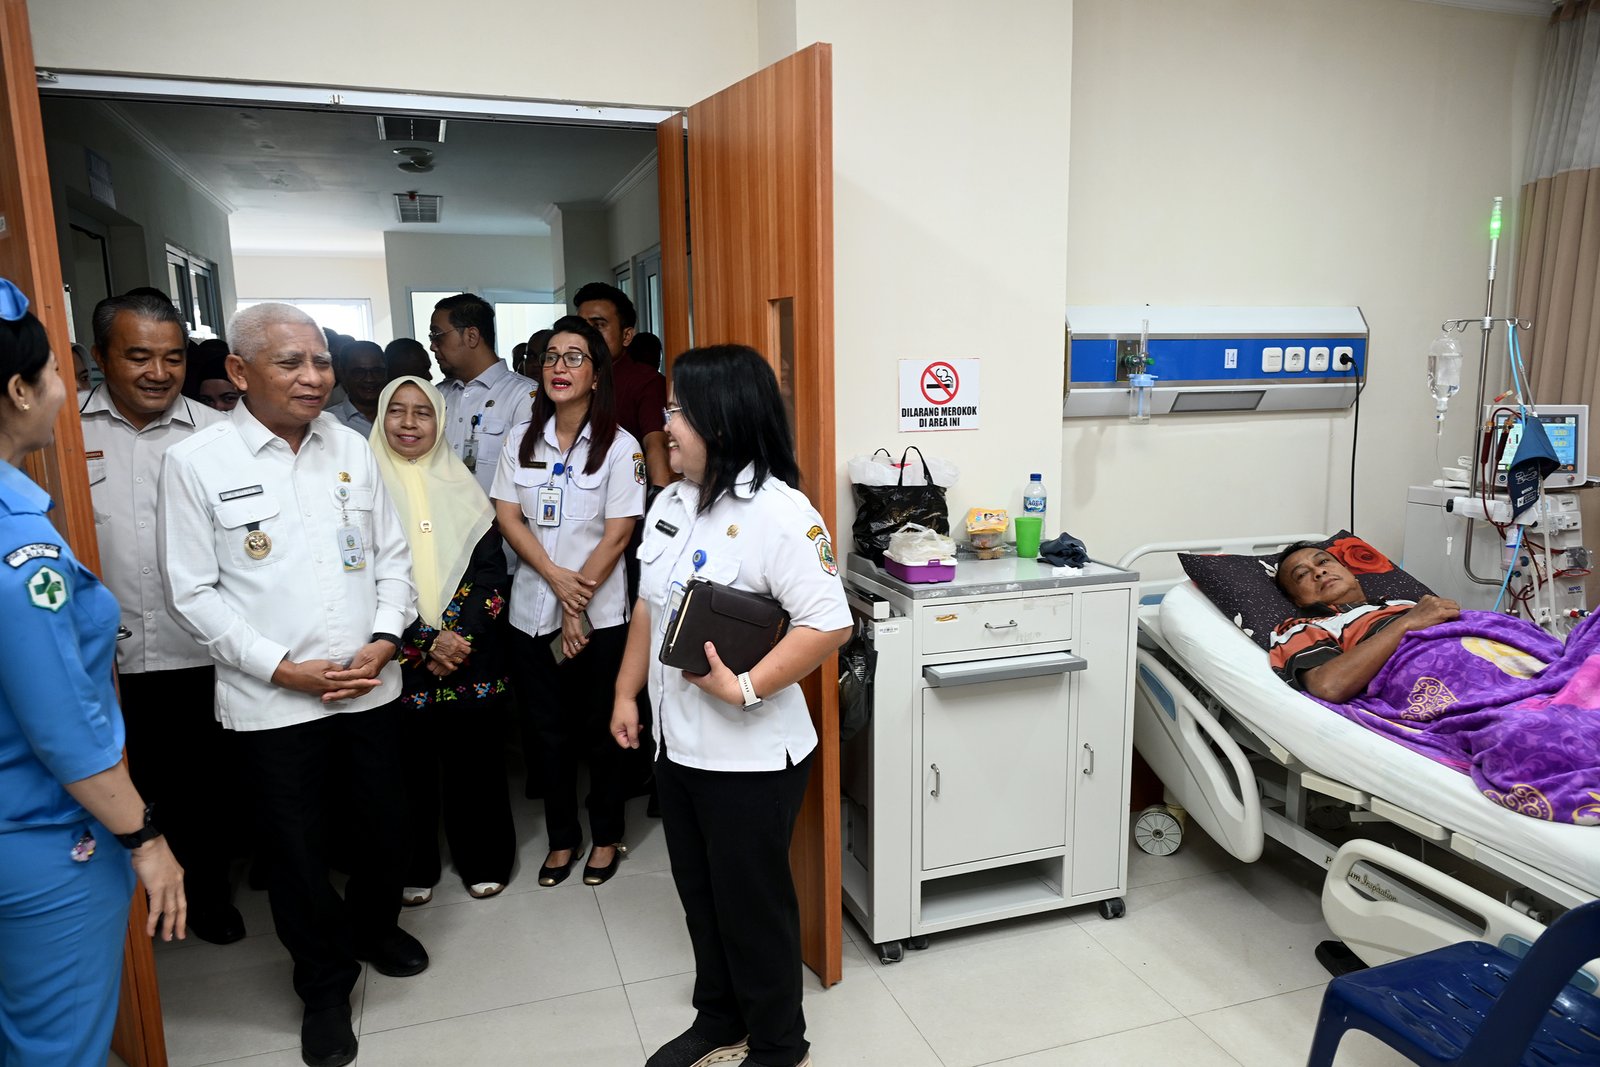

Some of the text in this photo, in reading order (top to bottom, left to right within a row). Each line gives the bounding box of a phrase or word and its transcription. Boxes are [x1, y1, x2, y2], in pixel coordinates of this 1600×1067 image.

[902, 406, 977, 417] DILARANG MEROKOK
[919, 417, 960, 427] DI AREA INI
